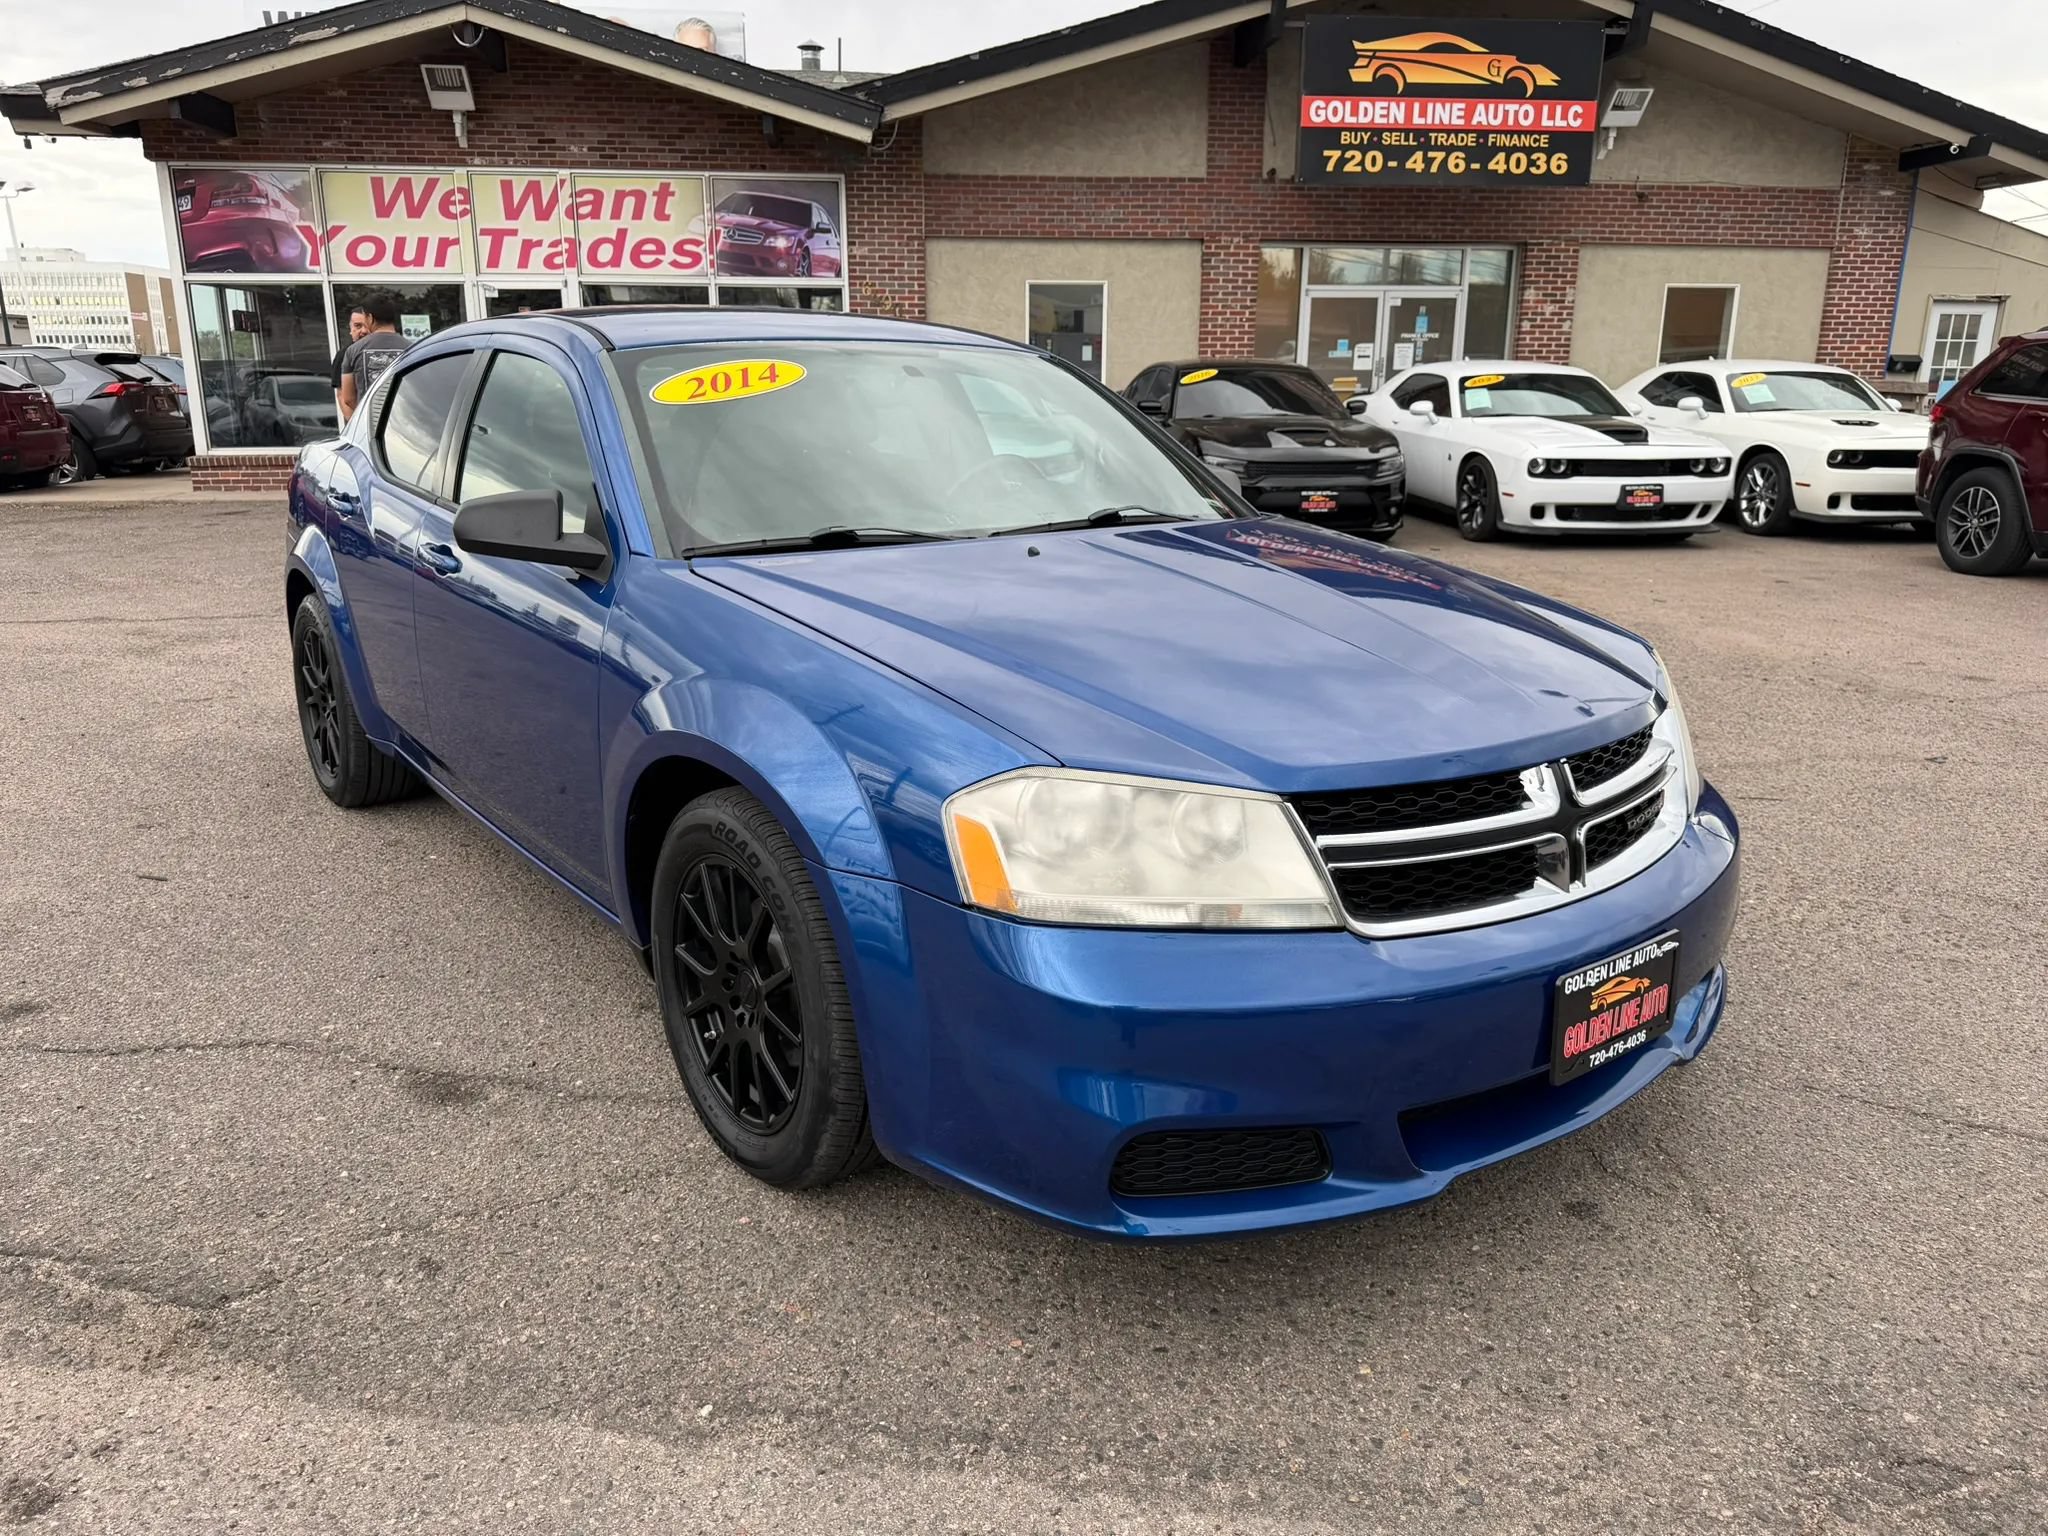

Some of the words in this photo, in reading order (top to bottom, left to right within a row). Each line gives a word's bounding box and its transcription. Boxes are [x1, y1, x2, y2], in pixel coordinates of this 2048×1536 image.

[1308, 99, 1405, 124] GOLDEN
[1411, 102, 1465, 126] LINE
[1470, 104, 1536, 127] AUTO
[1541, 105, 1584, 127] LLC
[1340, 131, 1371, 145] BUY
[1381, 132, 1417, 146] SELL
[1429, 133, 1477, 147] TRADE
[1487, 134, 1549, 147] FINANCE
[369, 176, 470, 219] We
[499, 178, 676, 222] Want
[296, 224, 460, 269] Your
[478, 228, 722, 271] Trades!
[685, 363, 780, 401] 2014
[714, 821, 762, 869] ROAD
[1564, 965, 1608, 995] GOLDEN
[1609, 954, 1633, 977] LINE
[1632, 943, 1657, 967] AUTO
[1563, 1010, 1614, 1058] GOLDEN
[1612, 996, 1641, 1034] LINE
[1639, 983, 1669, 1024] AUTO
[1589, 1029, 1647, 1068] 720-476-4036
